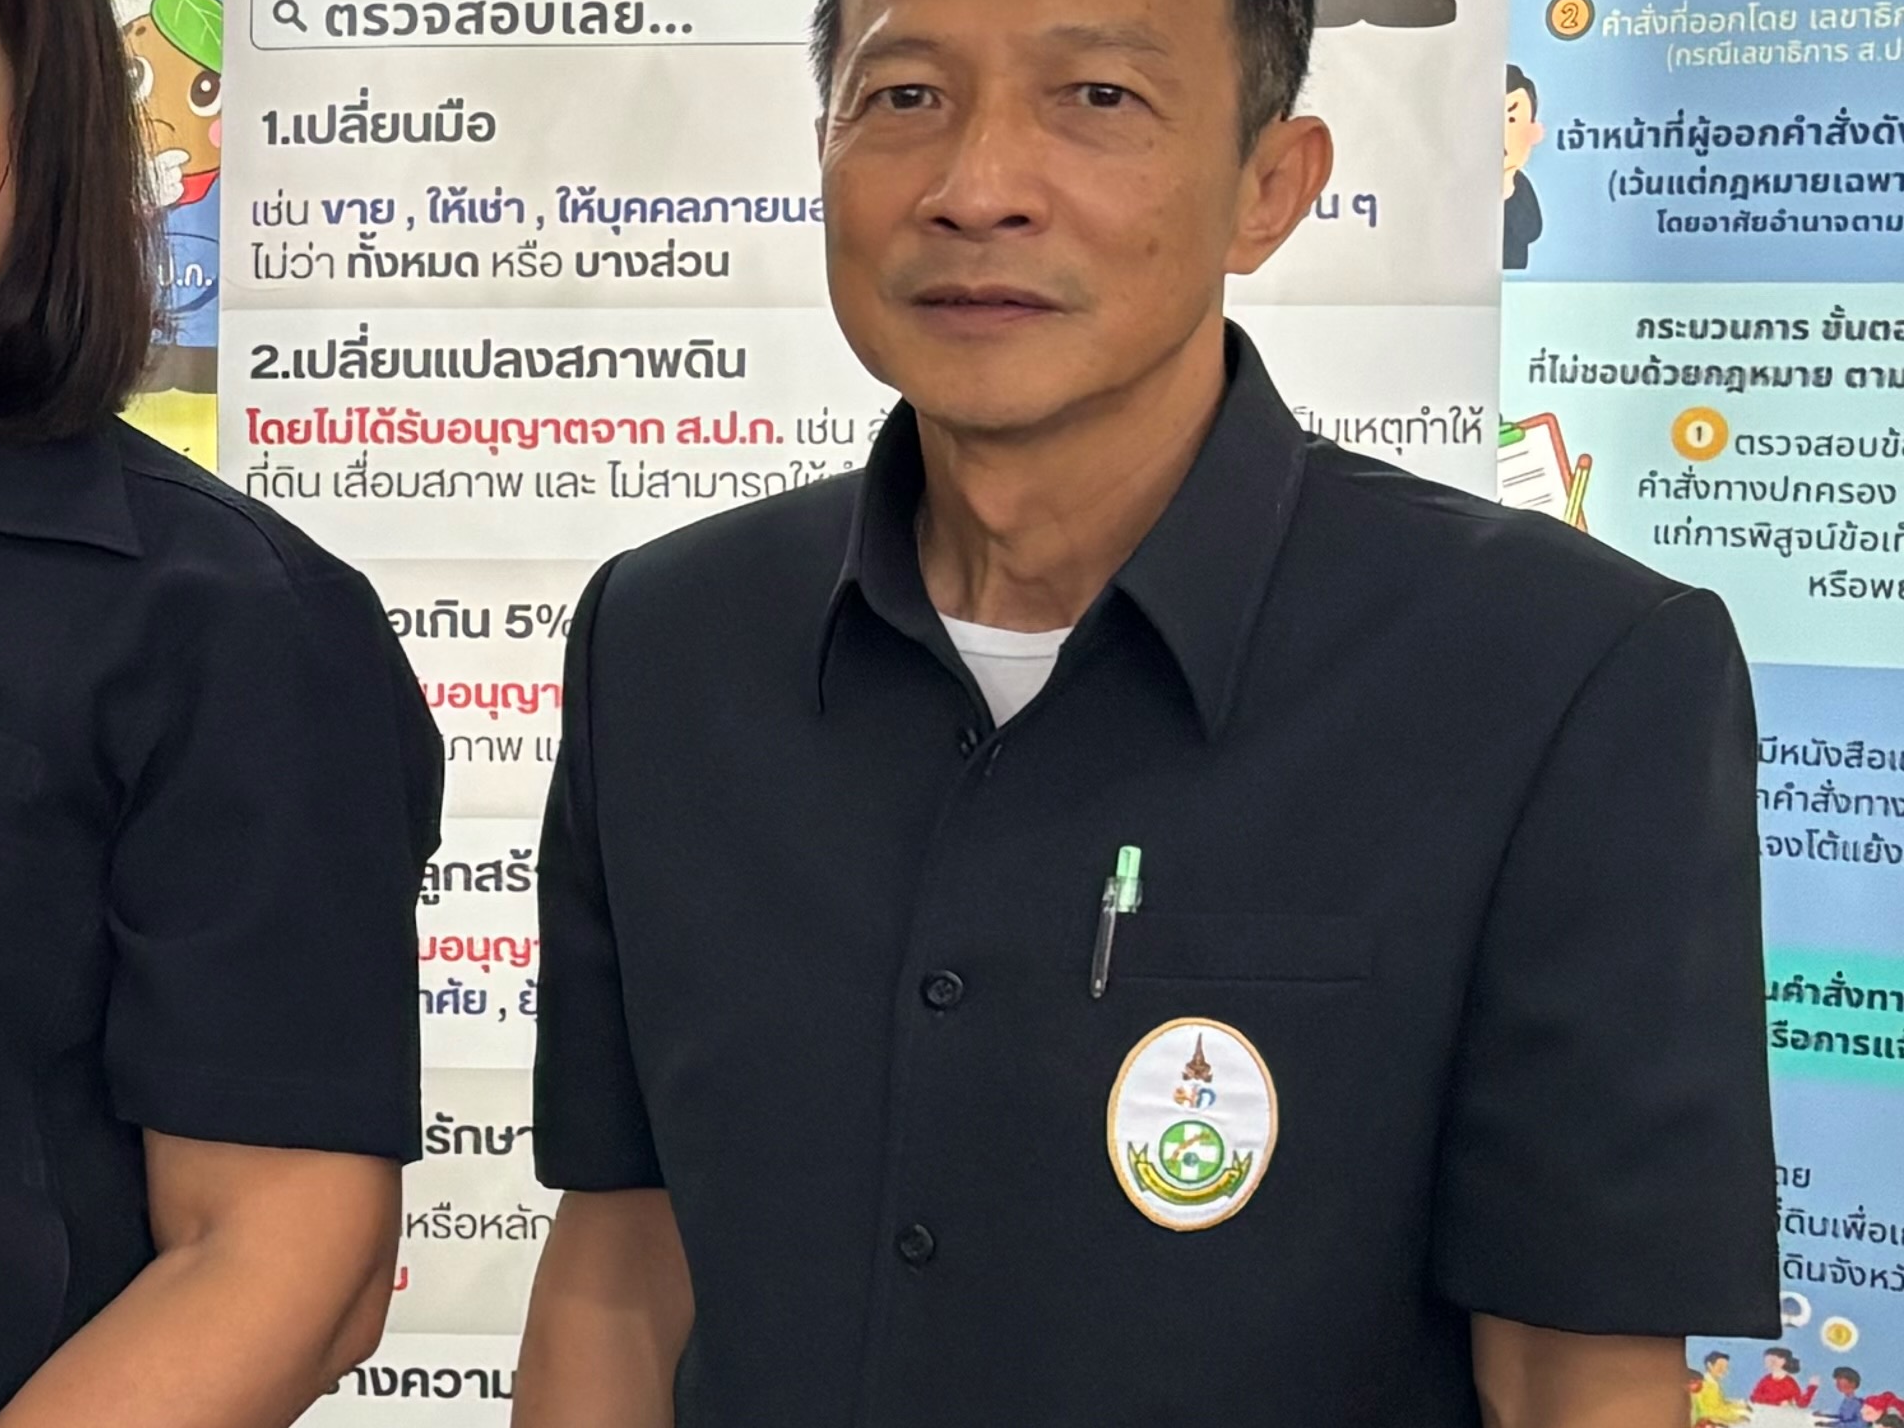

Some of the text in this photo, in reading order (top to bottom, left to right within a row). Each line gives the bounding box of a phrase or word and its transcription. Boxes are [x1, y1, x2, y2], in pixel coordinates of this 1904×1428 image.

[324, 0, 694, 38] ตรวจสอบเลย...
[261, 87, 497, 147] 1.เปลี่ยนมือ
[252, 189, 309, 227] เช่น
[321, 196, 396, 225] ขาย
[426, 186, 525, 226] ให้เช่า
[252, 231, 730, 281] ไม่ว่า ทั้งหมด หรือ บางส่วน
[1635, 316, 1810, 342] กระบวนการ
[250, 323, 747, 381] 2.เปลี่ยนแปลงสภาพดิน
[1527, 347, 1833, 395] ที่ไม่ชอบด้วยกฎหมาย
[245, 407, 665, 456] โดยไม่ได้รับอนุญาตจาก
[676, 411, 785, 446] ส.ป.ก.
[796, 408, 855, 445] เช่น
[1734, 426, 1904, 459] ตรวจสอบข้
[245, 451, 321, 499] ที่ดิน
[332, 450, 524, 499] เสื่อมสภาพ
[535, 465, 596, 499] และ
[1638, 464, 1897, 505] คำสั่งทางปกครอง
[388, 599, 490, 639] อเกิน
[444, 736, 523, 762] ภาพ
[1760, 828, 1904, 865] จงโต้แย้ง
[421, 848, 537, 905] ลูกสร้
[419, 977, 488, 1016] าศัย
[1770, 1019, 1904, 1060] รือการแ
